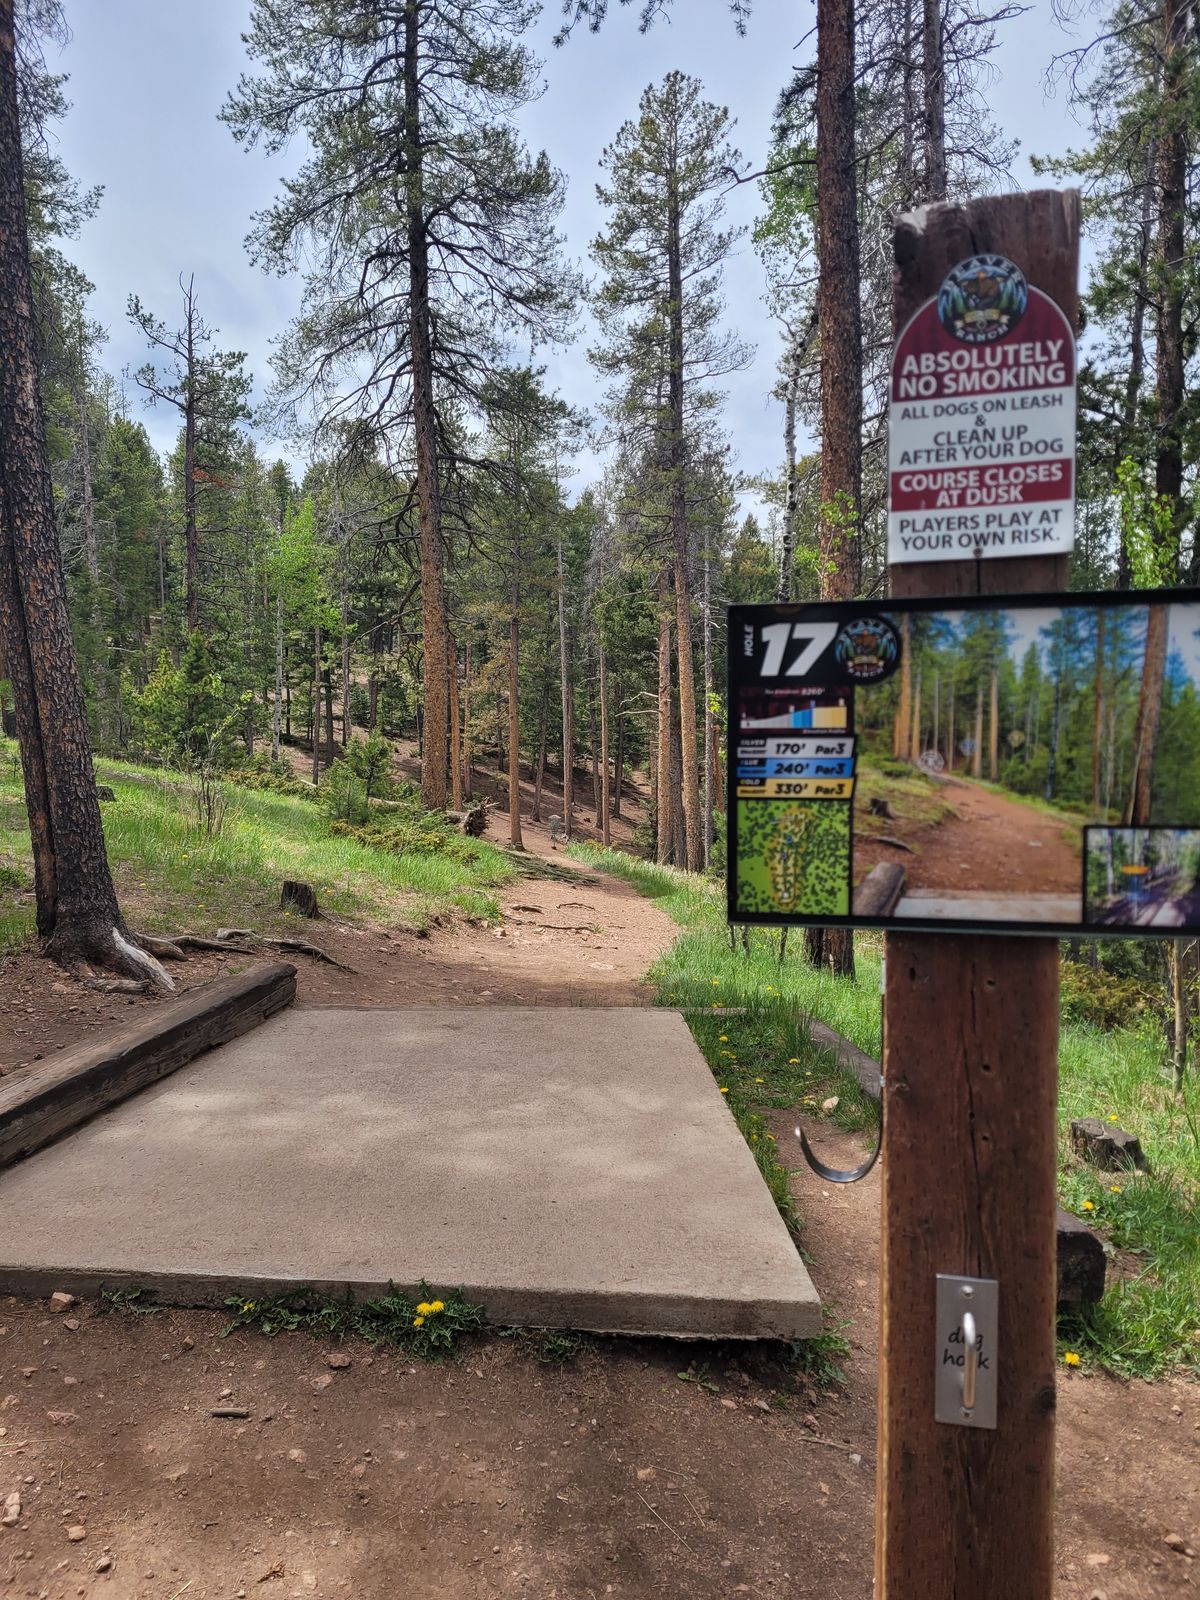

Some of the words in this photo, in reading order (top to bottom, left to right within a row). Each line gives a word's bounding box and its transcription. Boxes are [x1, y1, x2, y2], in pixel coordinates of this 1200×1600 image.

[955, 323, 1009, 342] RANCH
[902, 339, 1064, 376] ABSOLUTELY
[899, 375, 938, 398] NO
[943, 362, 1066, 395] SMOKING
[901, 406, 929, 421] ALL
[933, 402, 979, 418] DOGS
[982, 399, 1006, 413] ON
[1011, 394, 1063, 411] LEASH
[975, 414, 987, 427] &
[933, 427, 996, 447] CLEAN
[1002, 424, 1028, 441] UP
[899, 448, 958, 466] AFTER
[962, 442, 1015, 461] YOUR
[1019, 438, 1064, 456] DOG
[899, 469, 980, 492] COURSE
[984, 463, 1063, 487] CLOSES
[936, 489, 962, 507] AT
[966, 485, 1024, 506] DUSK
[900, 514, 980, 533] PLAYERS
[985, 510, 1033, 528] PLAY
[1038, 509, 1063, 524] AT
[901, 535, 953, 551] YOUR
[958, 531, 1005, 547] OWN
[1011, 528, 1061, 544] RISK.
[744, 624, 754, 656] HOLE
[760, 622, 839, 677] 17
[775, 743, 806, 755] 170'
[774, 763, 810, 775] 240'
[774, 783, 809, 794] 330'
[948, 1326, 984, 1350] dg
[943, 1348, 990, 1370] hok
